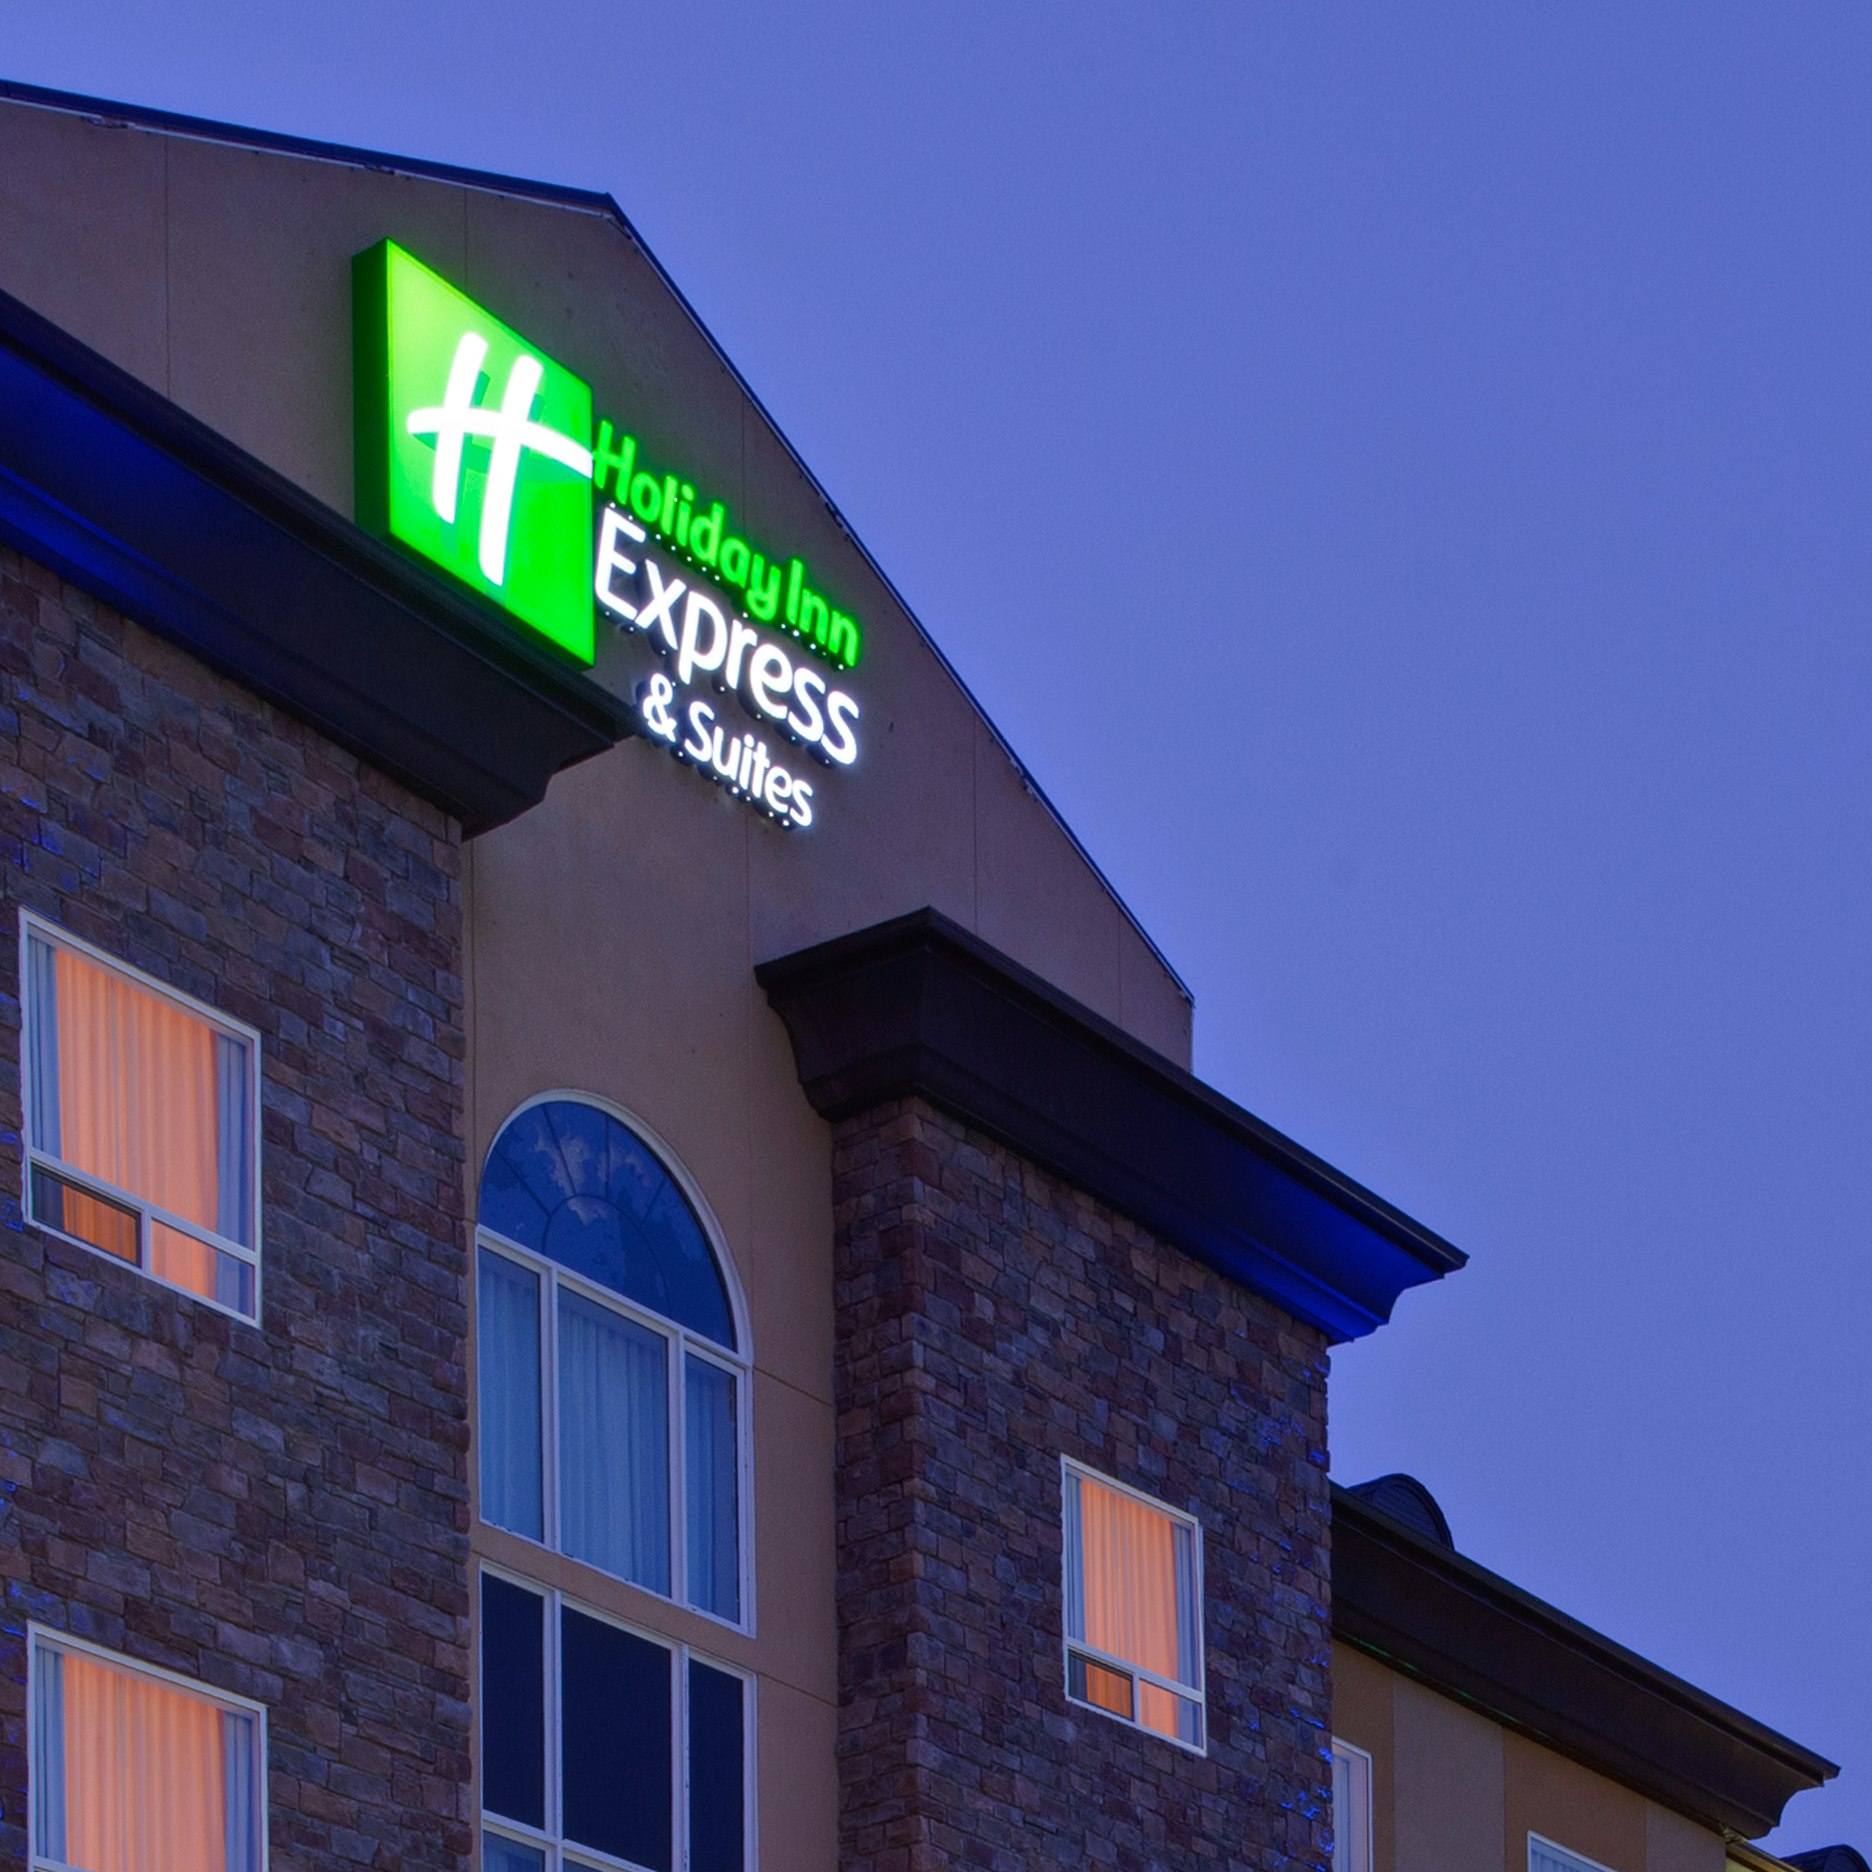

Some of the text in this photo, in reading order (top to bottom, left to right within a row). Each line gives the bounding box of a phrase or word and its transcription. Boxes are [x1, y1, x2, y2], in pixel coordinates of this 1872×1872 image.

[592, 419, 860, 668] Holiday Inn
[594, 506, 860, 766] Express
[642, 672, 814, 828] & Suites
